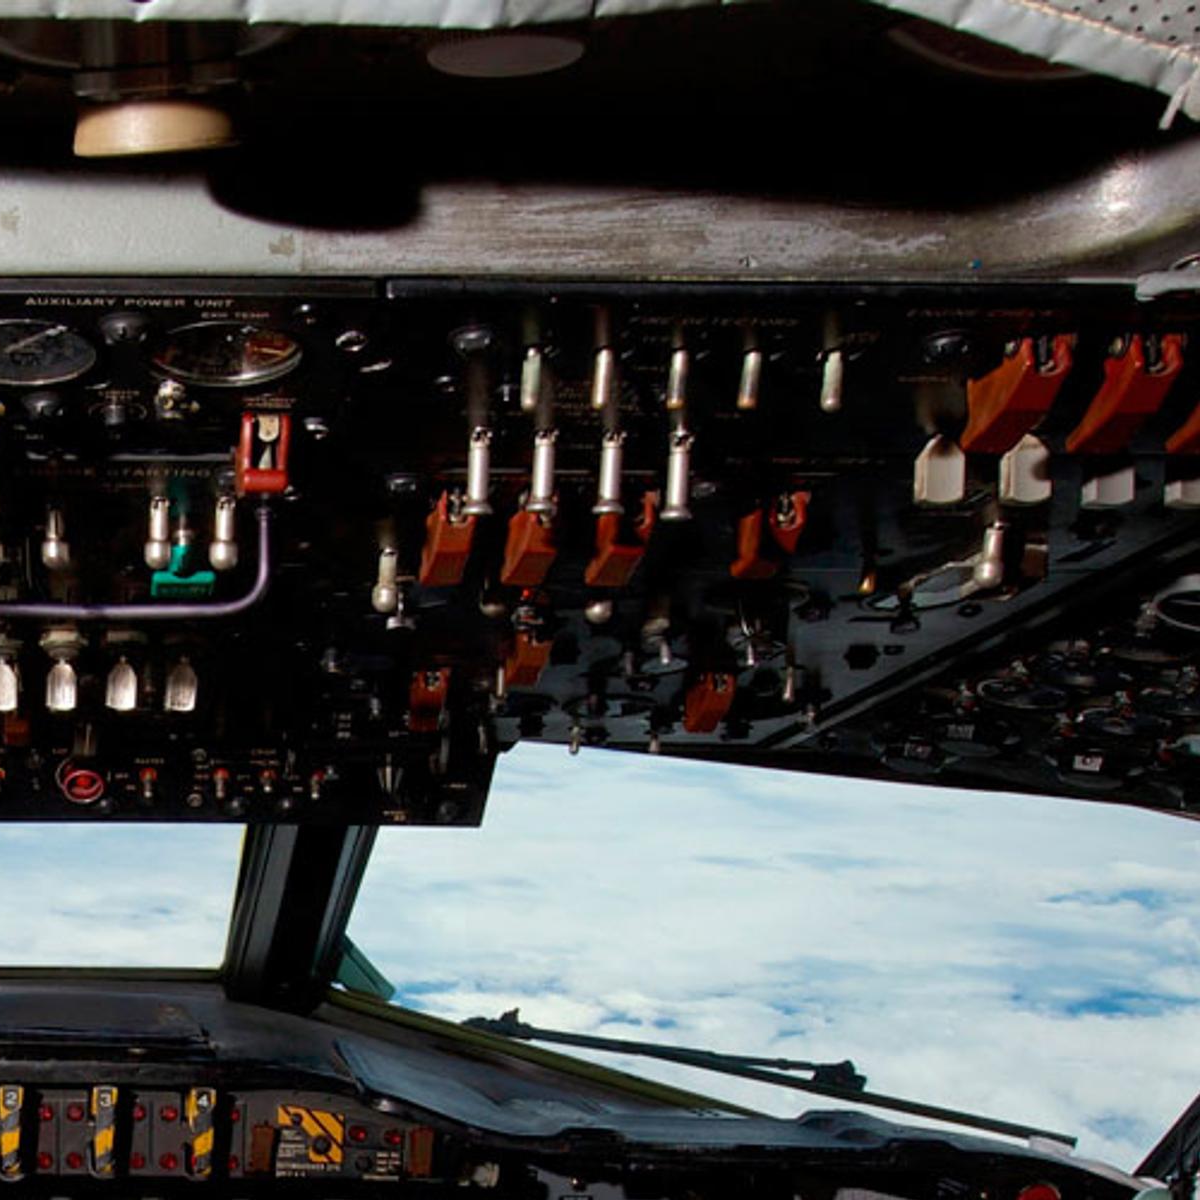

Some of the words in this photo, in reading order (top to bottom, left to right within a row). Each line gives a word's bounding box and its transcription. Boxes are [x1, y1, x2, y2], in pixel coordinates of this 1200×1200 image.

[24, 296, 117, 307] AUXILIARY
[123, 297, 186, 307] POWER
[194, 298, 236, 308] UNIT
[5, 1092, 17, 1106] 2
[100, 1093, 112, 1107] 3
[197, 1094, 209, 1107] 4
